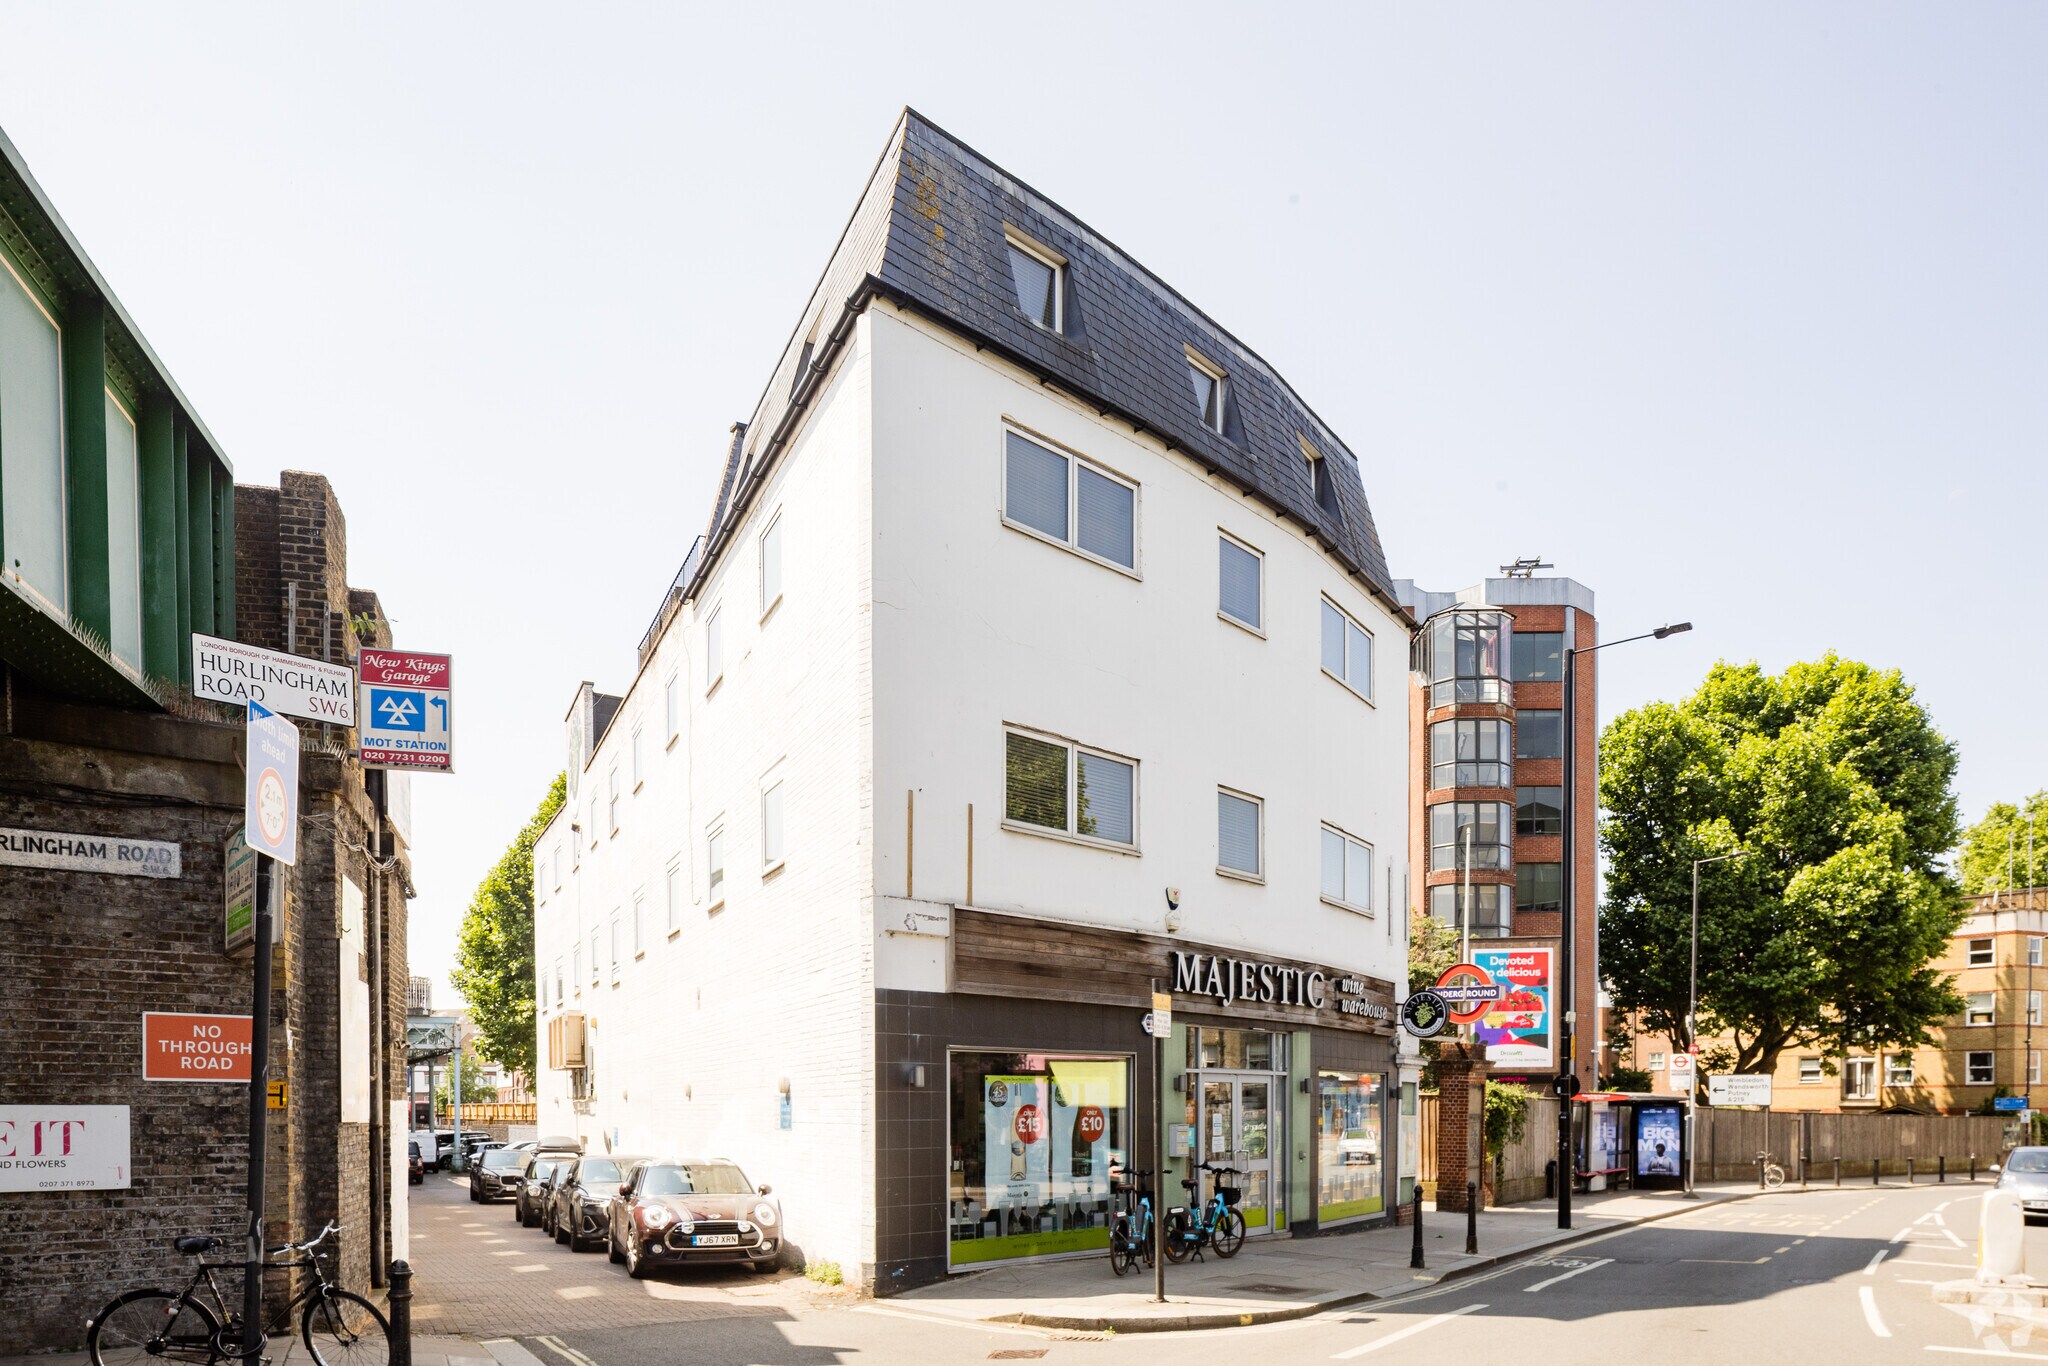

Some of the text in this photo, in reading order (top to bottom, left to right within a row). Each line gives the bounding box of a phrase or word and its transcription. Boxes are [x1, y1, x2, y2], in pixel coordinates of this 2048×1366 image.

[201, 641, 228, 652] LONDON
[229, 646, 260, 659] BOROUGH
[272, 656, 316, 671] HAMMERSMITH
[324, 667, 347, 678] FULHAM
[365, 654, 446, 674] New Kings
[200, 652, 348, 698] HURLINGHAM
[381, 669, 431, 685] Garage
[201, 674, 265, 702] ROAD
[309, 697, 349, 719] SW6
[252, 708, 296, 750] Width limit
[261, 738, 286, 764] ahead
[364, 737, 447, 751] MOT STATION
[364, 751, 446, 763] 020 7731 0200
[118, 844, 172, 865] ROAD
[1489, 955, 1535, 966] Devoted
[1174, 950, 1325, 1009] MAJESTIC
[1496, 968, 1542, 977] delicious
[1341, 975, 1365, 996] wine
[1435, 989, 1497, 998] NDERGROUND
[1341, 998, 1388, 1020] warehouse
[1404, 994, 1443, 1014] MAJESTIC
[193, 1025, 222, 1038] NO
[158, 1040, 252, 1055] THROUGH
[181, 1056, 233, 1070] ROAD
[1018, 1117, 1041, 1133] £15
[1081, 1117, 1103, 1132] £10
[1643, 1127, 1675, 1140] BIG
[1638, 1139, 1680, 1152] MAN
[16, 1160, 67, 1169] FLOWERS
[698, 1235, 737, 1244] YJ67 XRN
